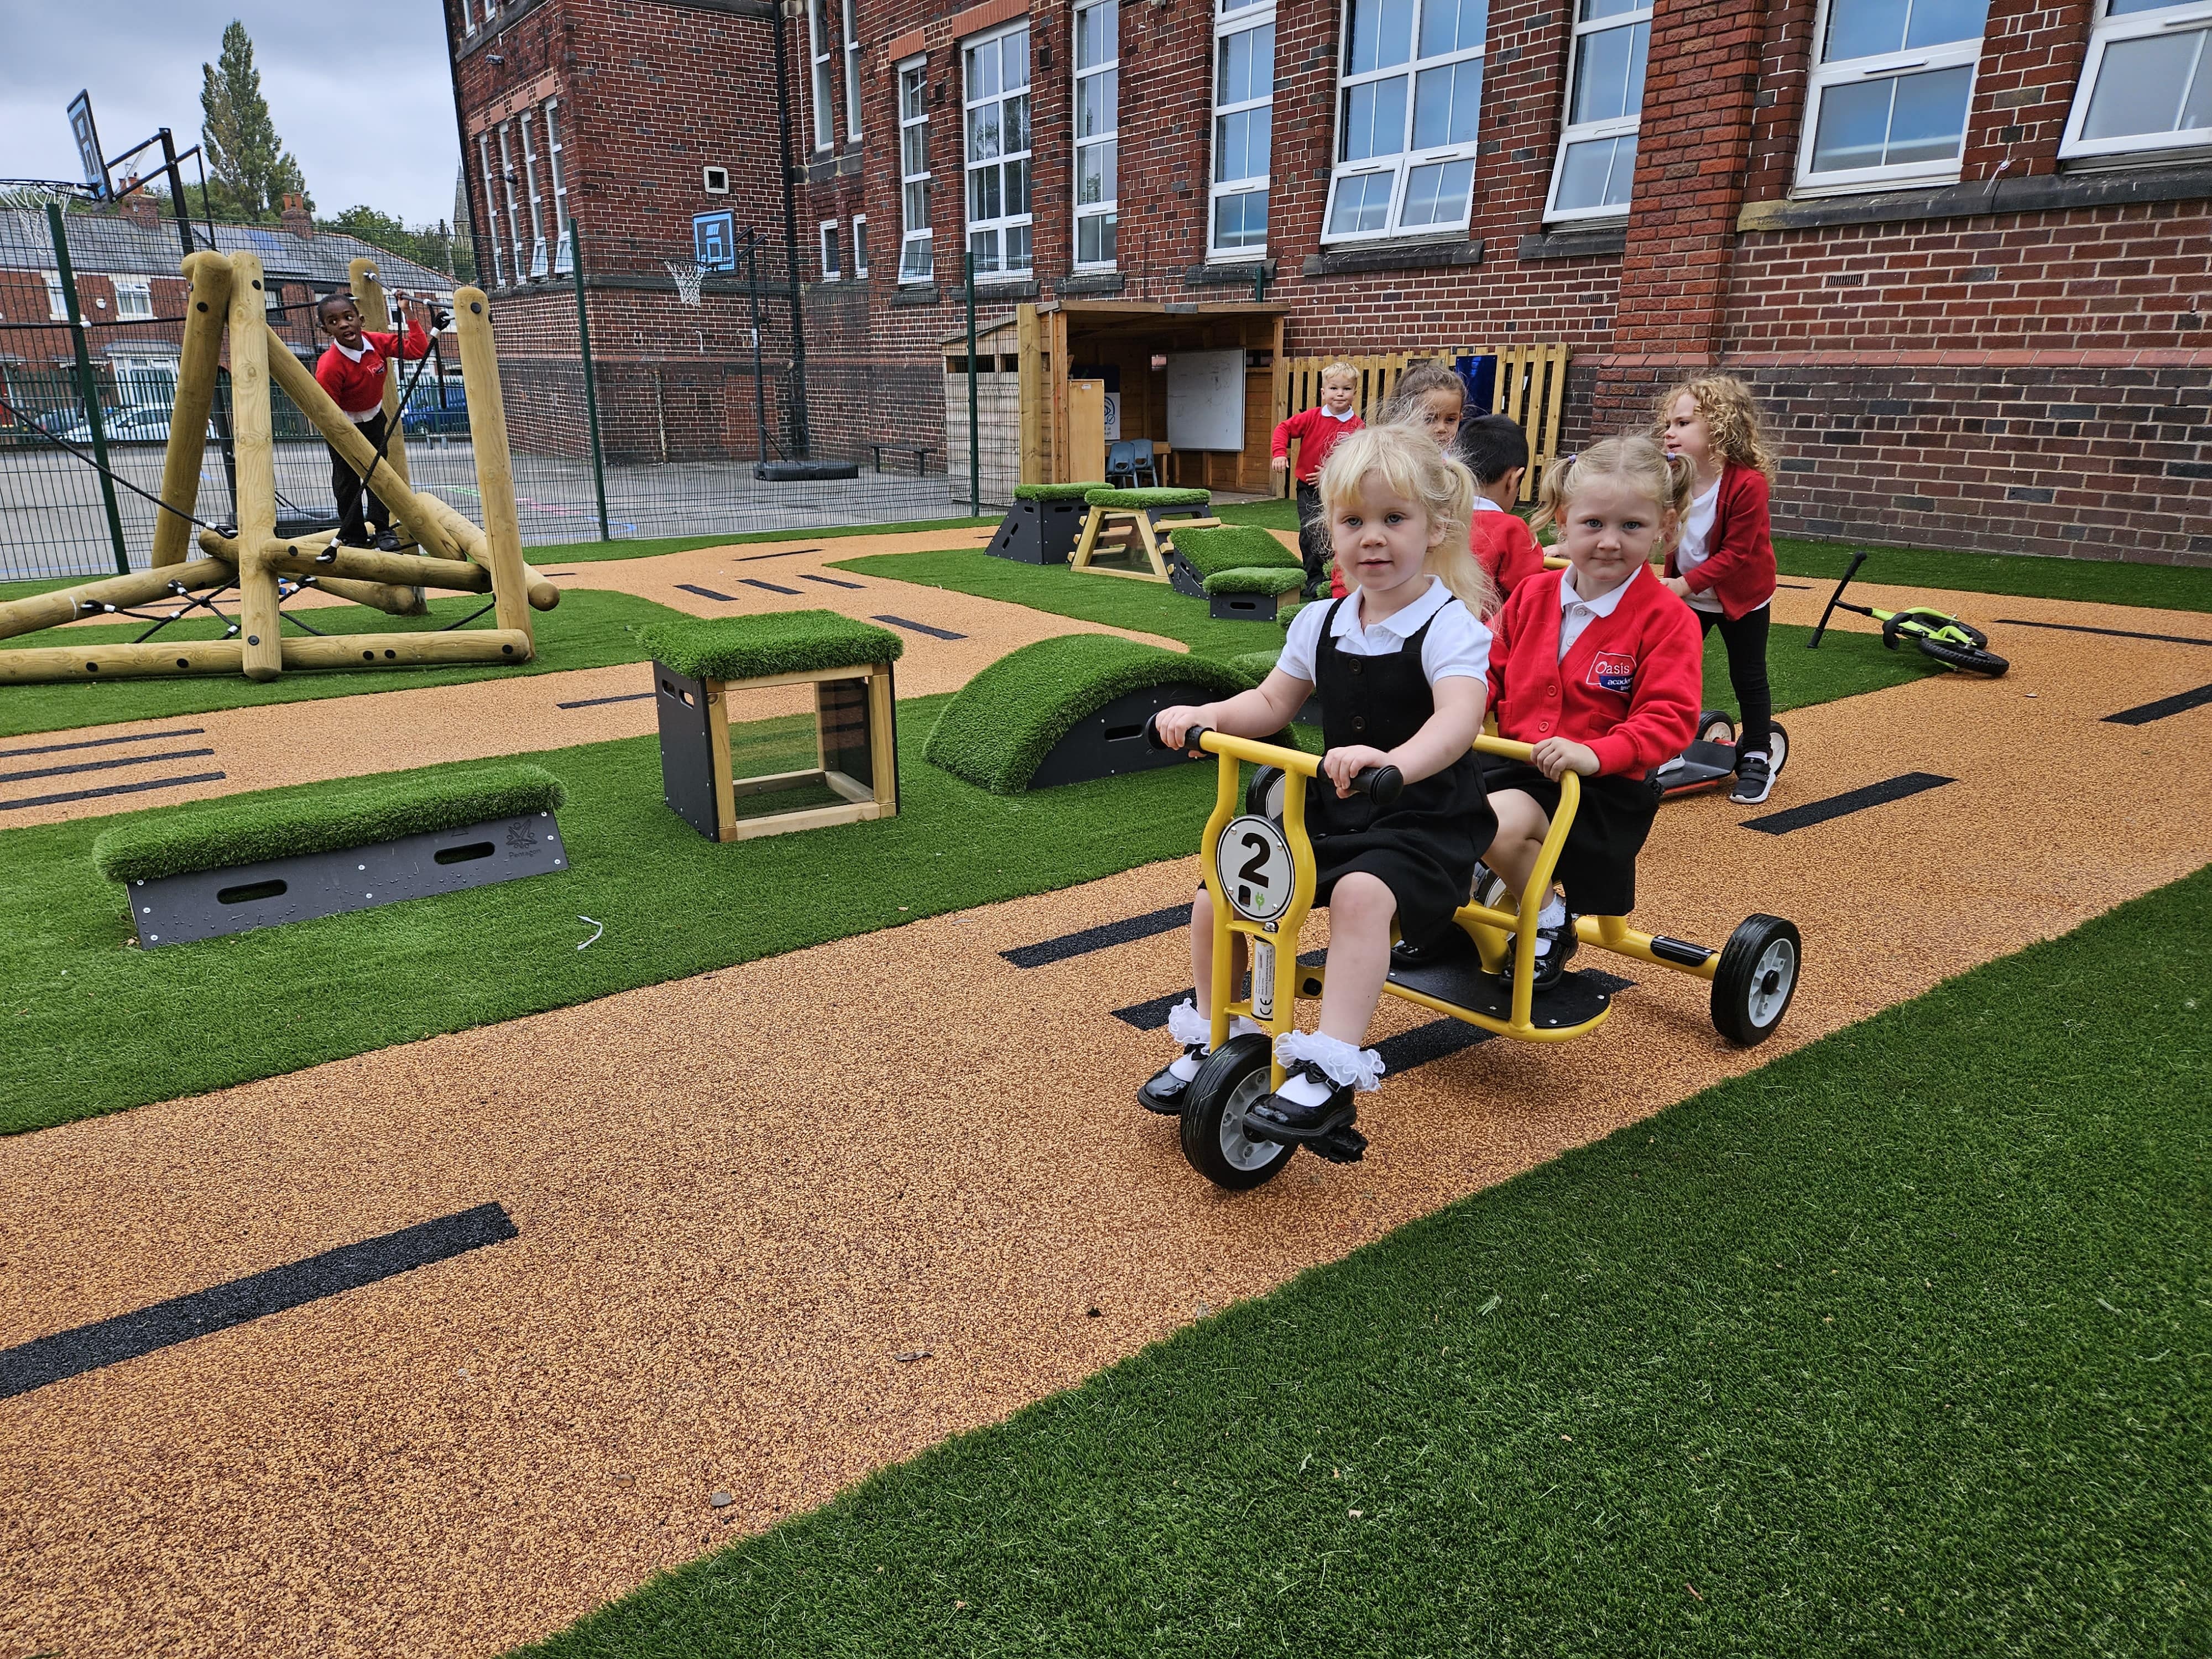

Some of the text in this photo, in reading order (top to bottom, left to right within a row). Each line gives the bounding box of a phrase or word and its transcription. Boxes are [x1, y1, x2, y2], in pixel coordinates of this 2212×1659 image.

[1595, 661, 1630, 674] Oasis
[508, 849, 541, 858] Pentagon
[1238, 832, 1271, 889] 2
